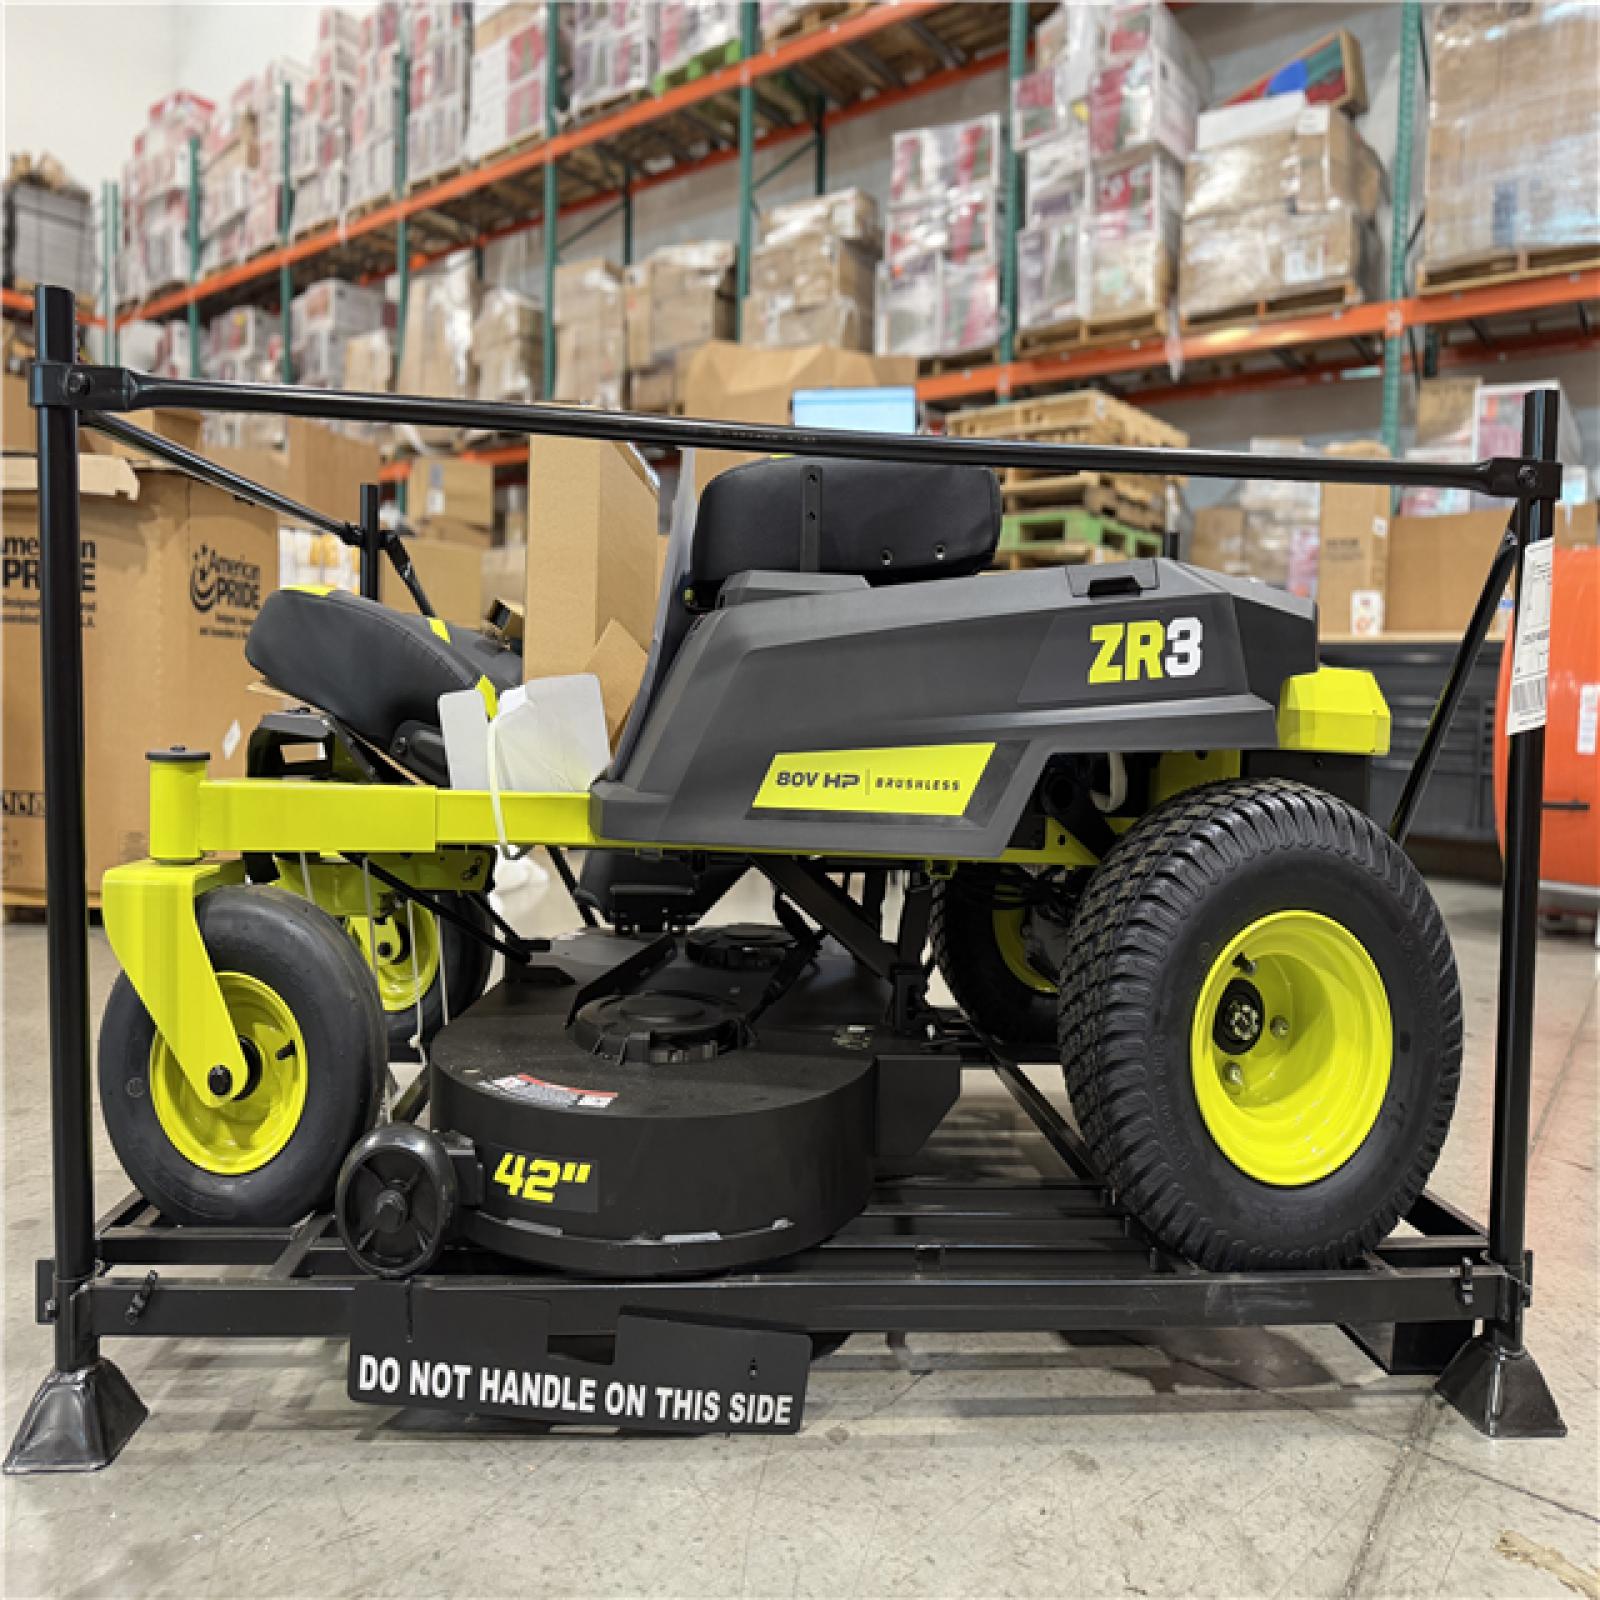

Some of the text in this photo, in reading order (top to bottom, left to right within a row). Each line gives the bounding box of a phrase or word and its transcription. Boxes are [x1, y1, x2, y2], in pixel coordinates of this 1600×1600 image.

[215, 577, 261, 611] PRIDE
[1088, 617, 1203, 684] ZR3
[776, 771, 961, 791] 80V HP BRUSHLESS
[494, 1152, 592, 1203] 42"
[359, 1354, 793, 1425] DO NOT HANDLE ON THIS SIDE
